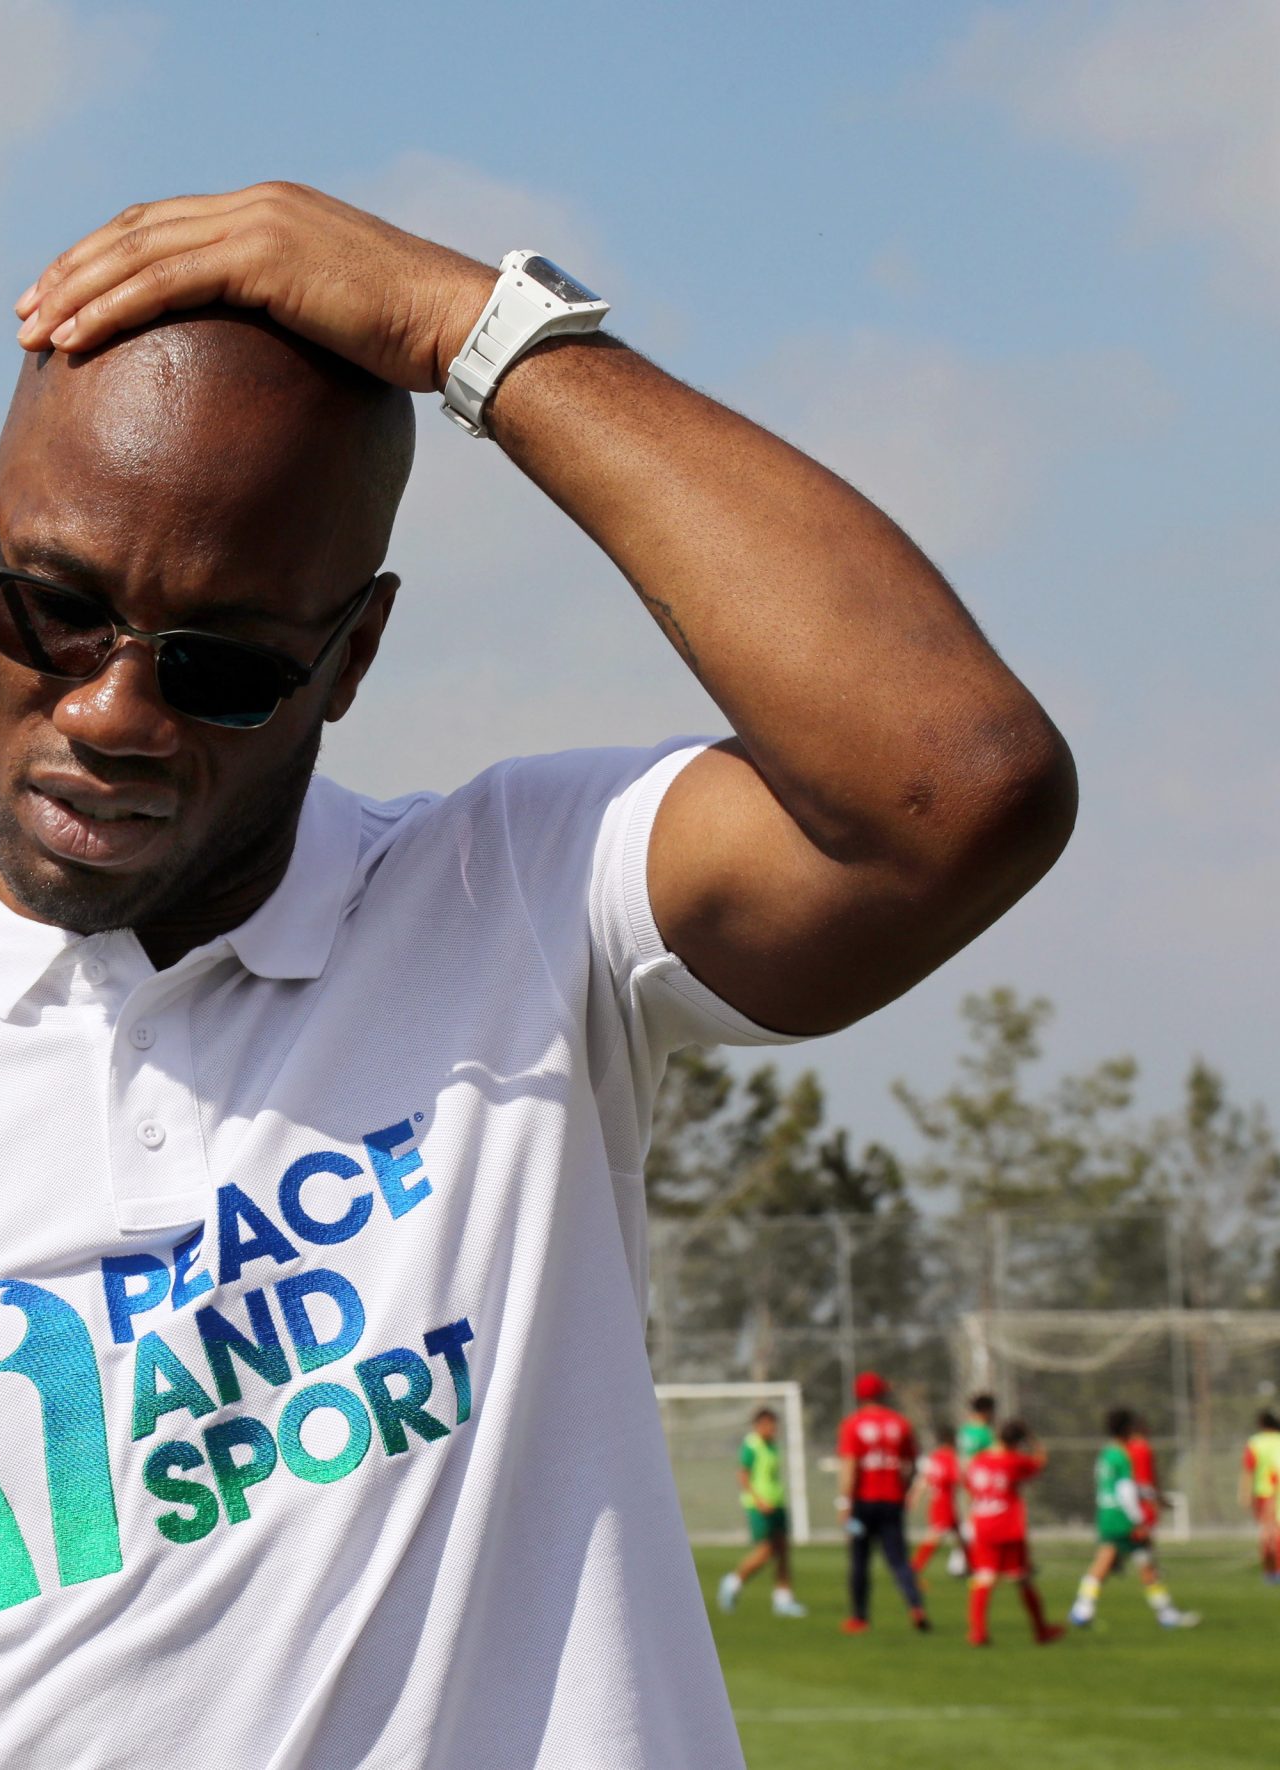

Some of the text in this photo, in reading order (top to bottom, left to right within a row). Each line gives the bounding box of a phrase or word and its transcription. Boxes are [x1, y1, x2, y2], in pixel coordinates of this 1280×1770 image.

[101, 1118, 432, 1344] PEACE
[131, 1268, 365, 1441] AND
[141, 1317, 475, 1544] SPORT
